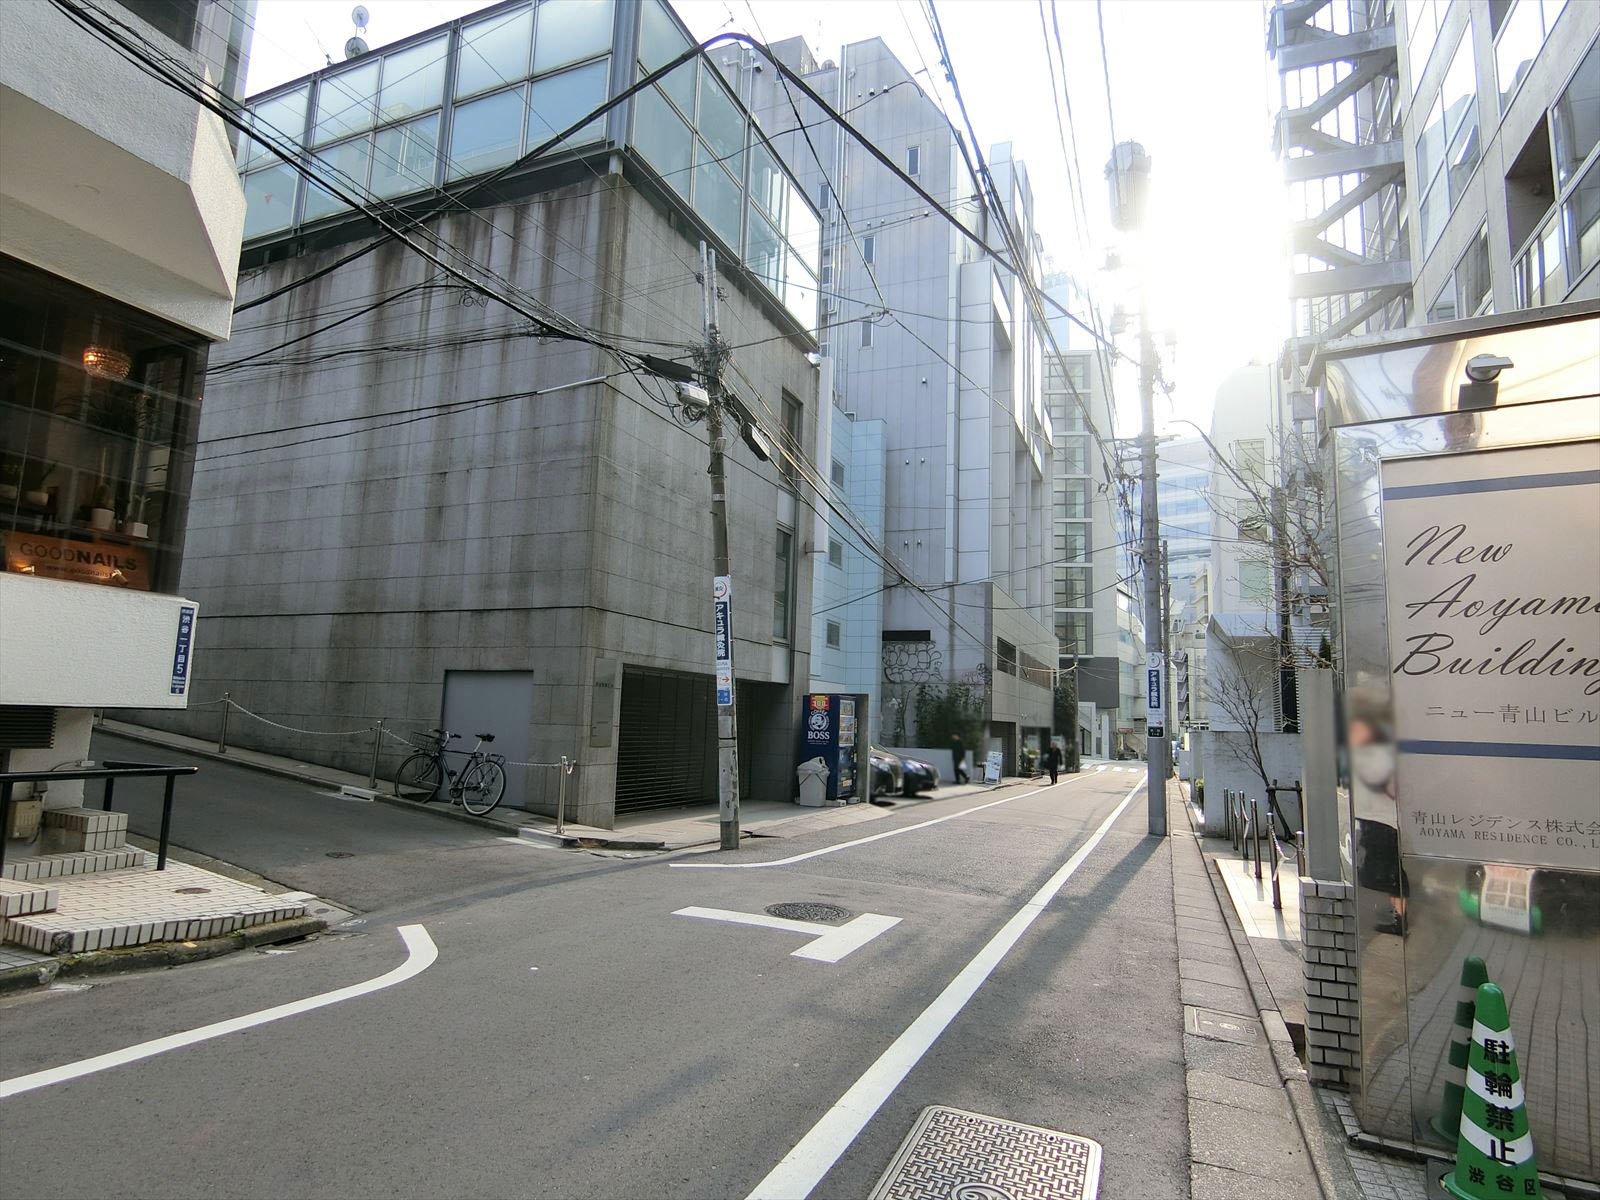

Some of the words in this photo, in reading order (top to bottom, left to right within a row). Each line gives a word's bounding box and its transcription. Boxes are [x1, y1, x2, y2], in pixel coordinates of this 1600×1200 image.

[20, 542, 137, 571] GOODNAILS
[1404, 523, 1513, 566] New
[1405, 573, 1600, 635] Aoyam
[1426, 703, 1598, 724] ニュー青山ビル
[808, 730, 830, 740] BOSS
[1419, 827, 1466, 840] AOYAMA
[1474, 831, 1548, 845] RESIDENCE
[1483, 1038, 1516, 1166] 駐輪禁止
[1468, 1165, 1537, 1196] 渋谷区
